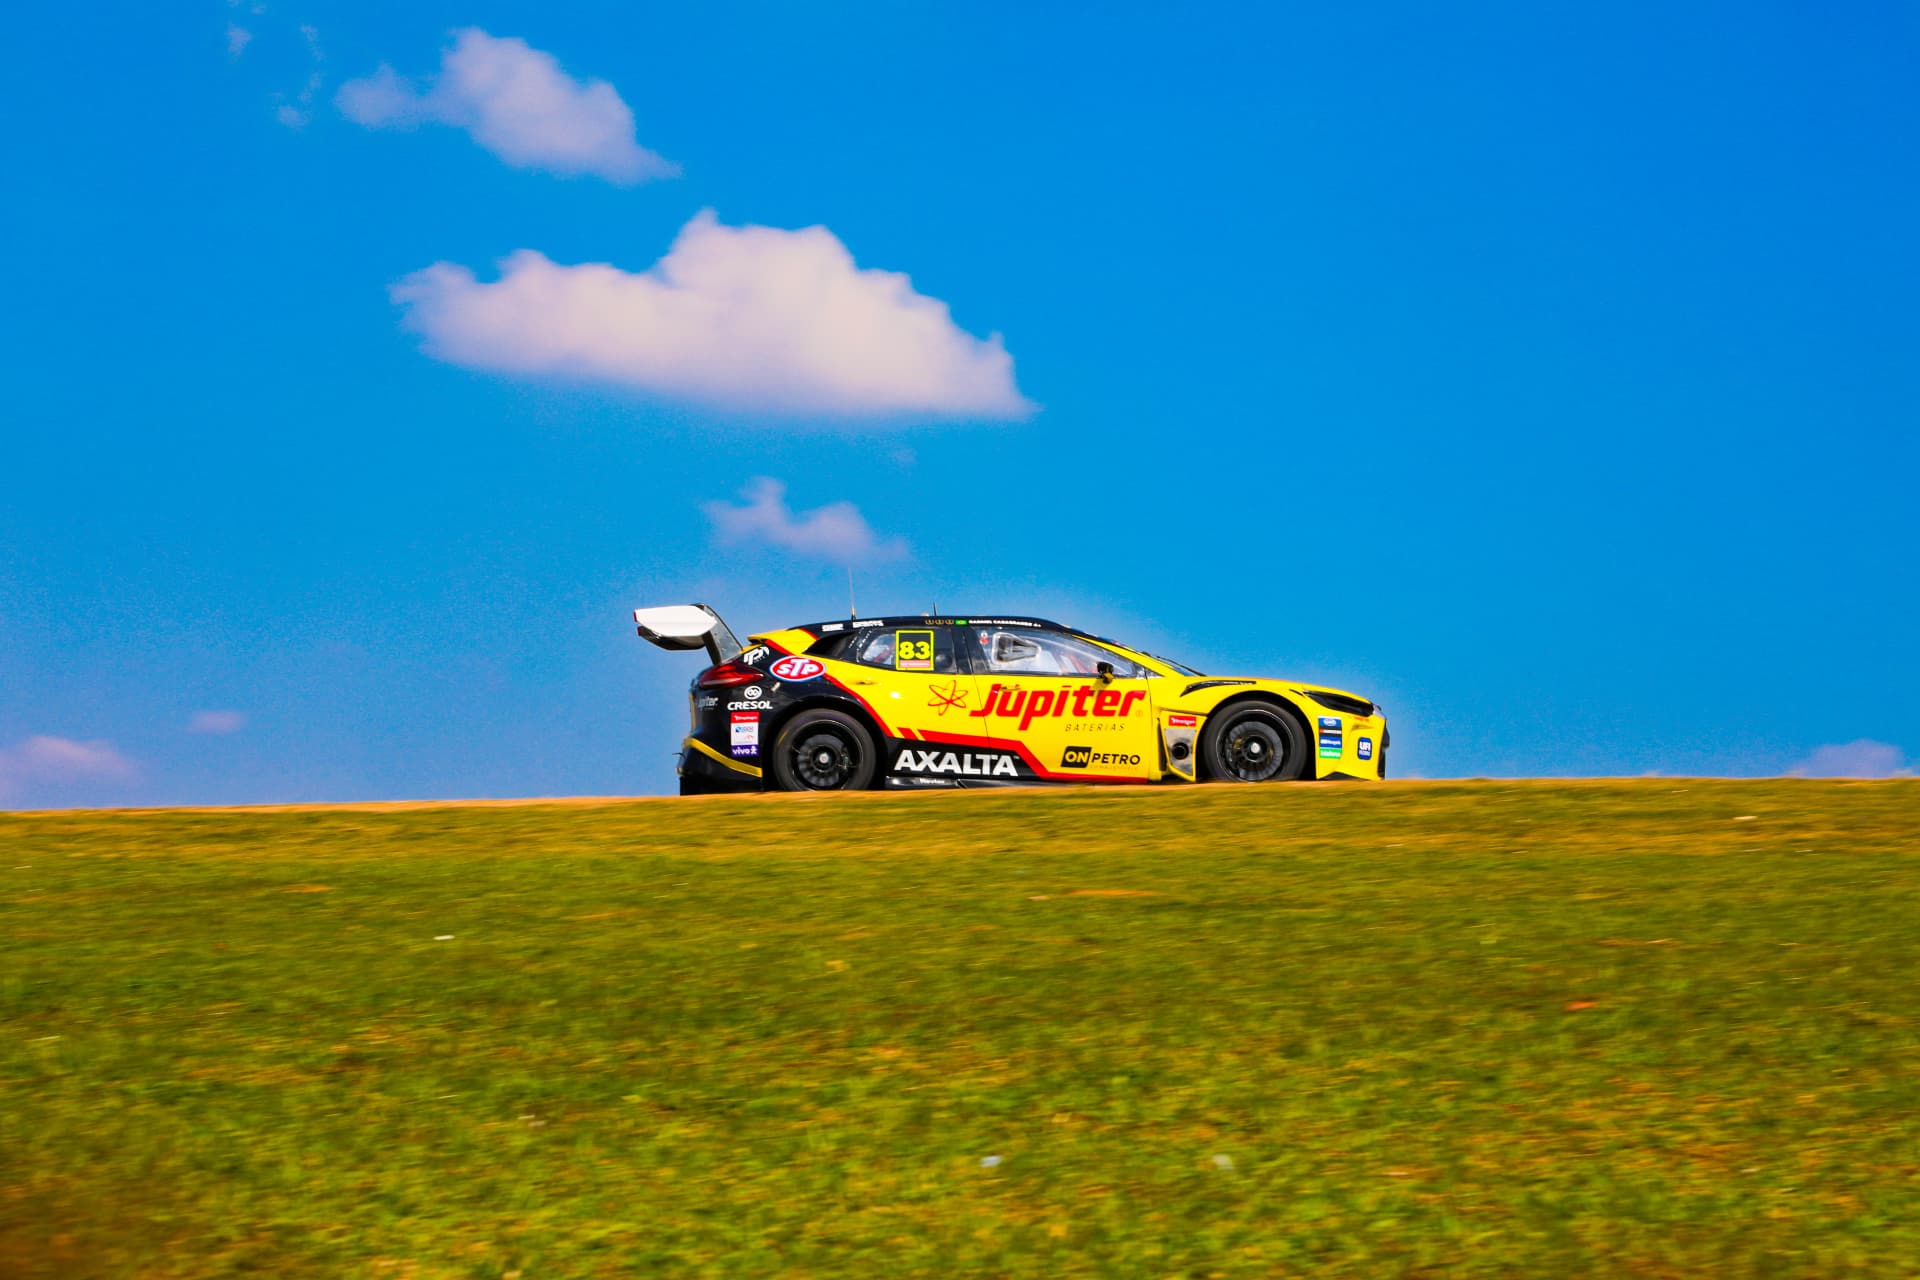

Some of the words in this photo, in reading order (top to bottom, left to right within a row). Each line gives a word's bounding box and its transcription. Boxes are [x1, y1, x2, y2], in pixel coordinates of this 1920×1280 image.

[899, 641, 931, 660] 83
[777, 658, 819, 677] STP
[727, 701, 773, 711] CRESOL
[1065, 723, 1125, 733] BATERIAS
[732, 747, 750, 755] vivo
[894, 749, 1019, 777] AXALTA
